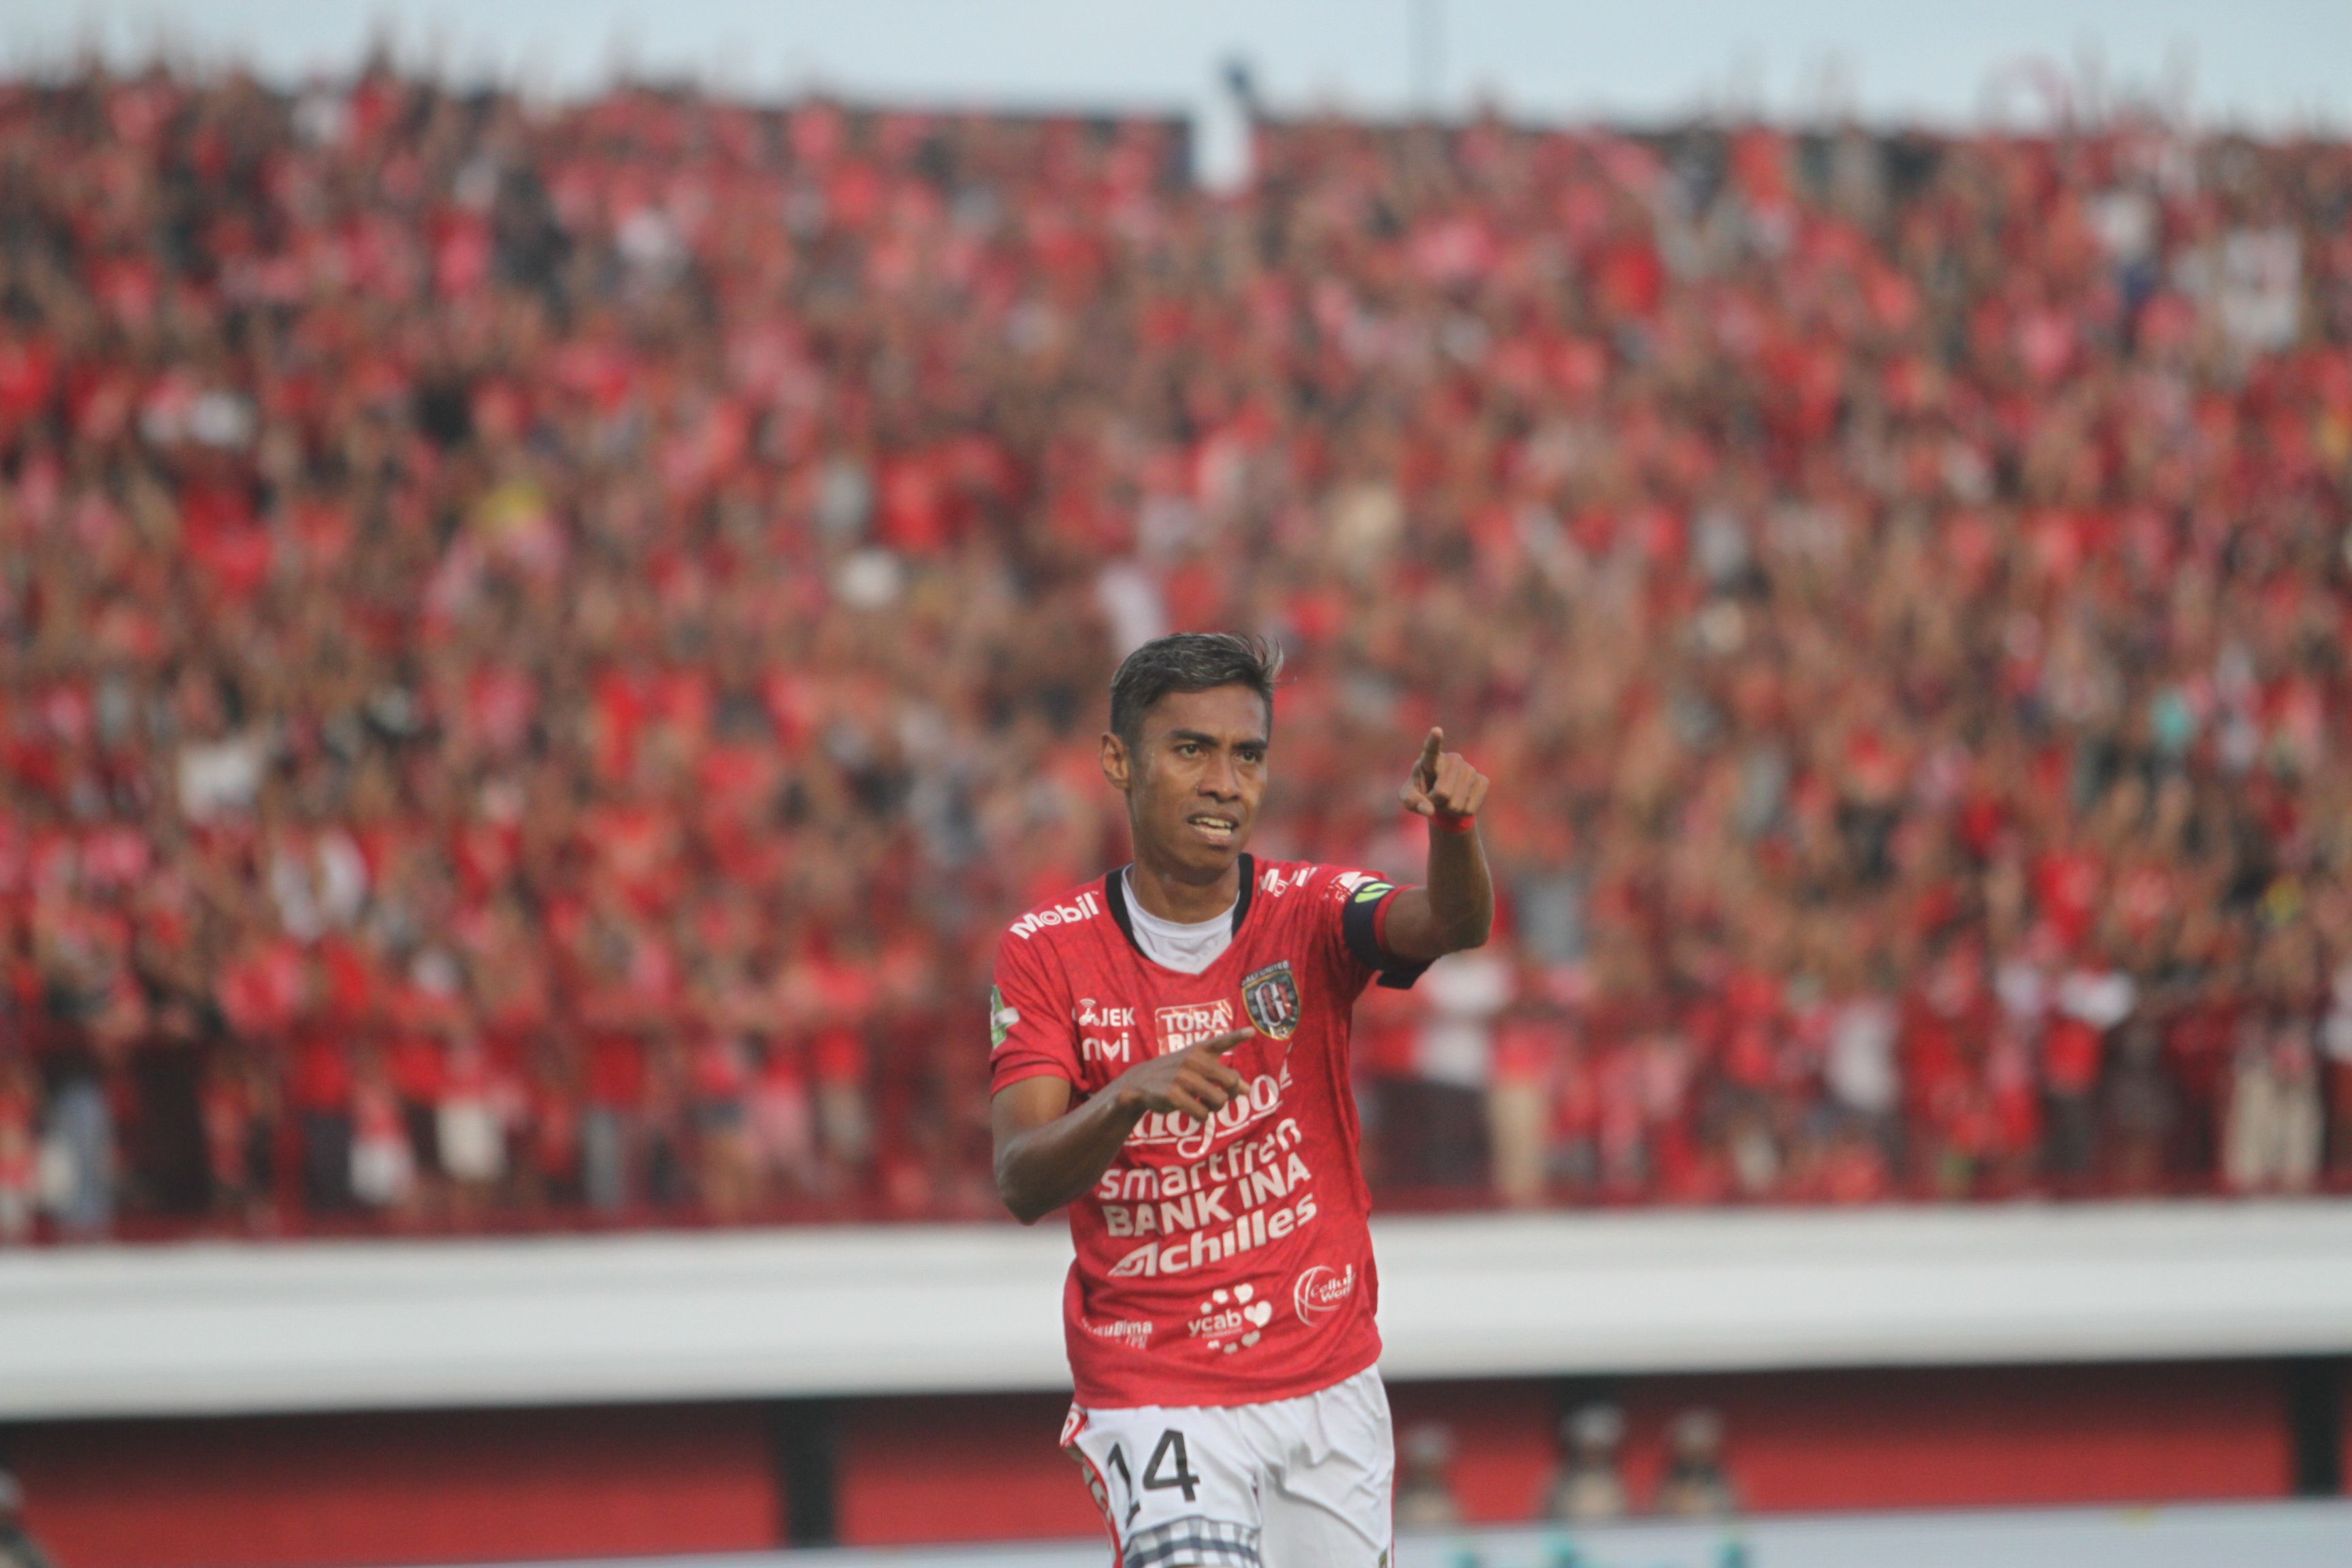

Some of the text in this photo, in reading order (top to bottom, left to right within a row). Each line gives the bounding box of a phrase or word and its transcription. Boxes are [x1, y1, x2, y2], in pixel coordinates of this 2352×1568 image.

[1009, 892, 1100, 940] Mobil
[1160, 1009, 1229, 1033] TORA
[1098, 1117, 1302, 1200] smartfren
[1102, 1151, 1311, 1239] BANK INA
[1107, 1192, 1318, 1277] Achilles
[1187, 1308, 1243, 1338] ycab
[1107, 1427, 1200, 1529] 14
